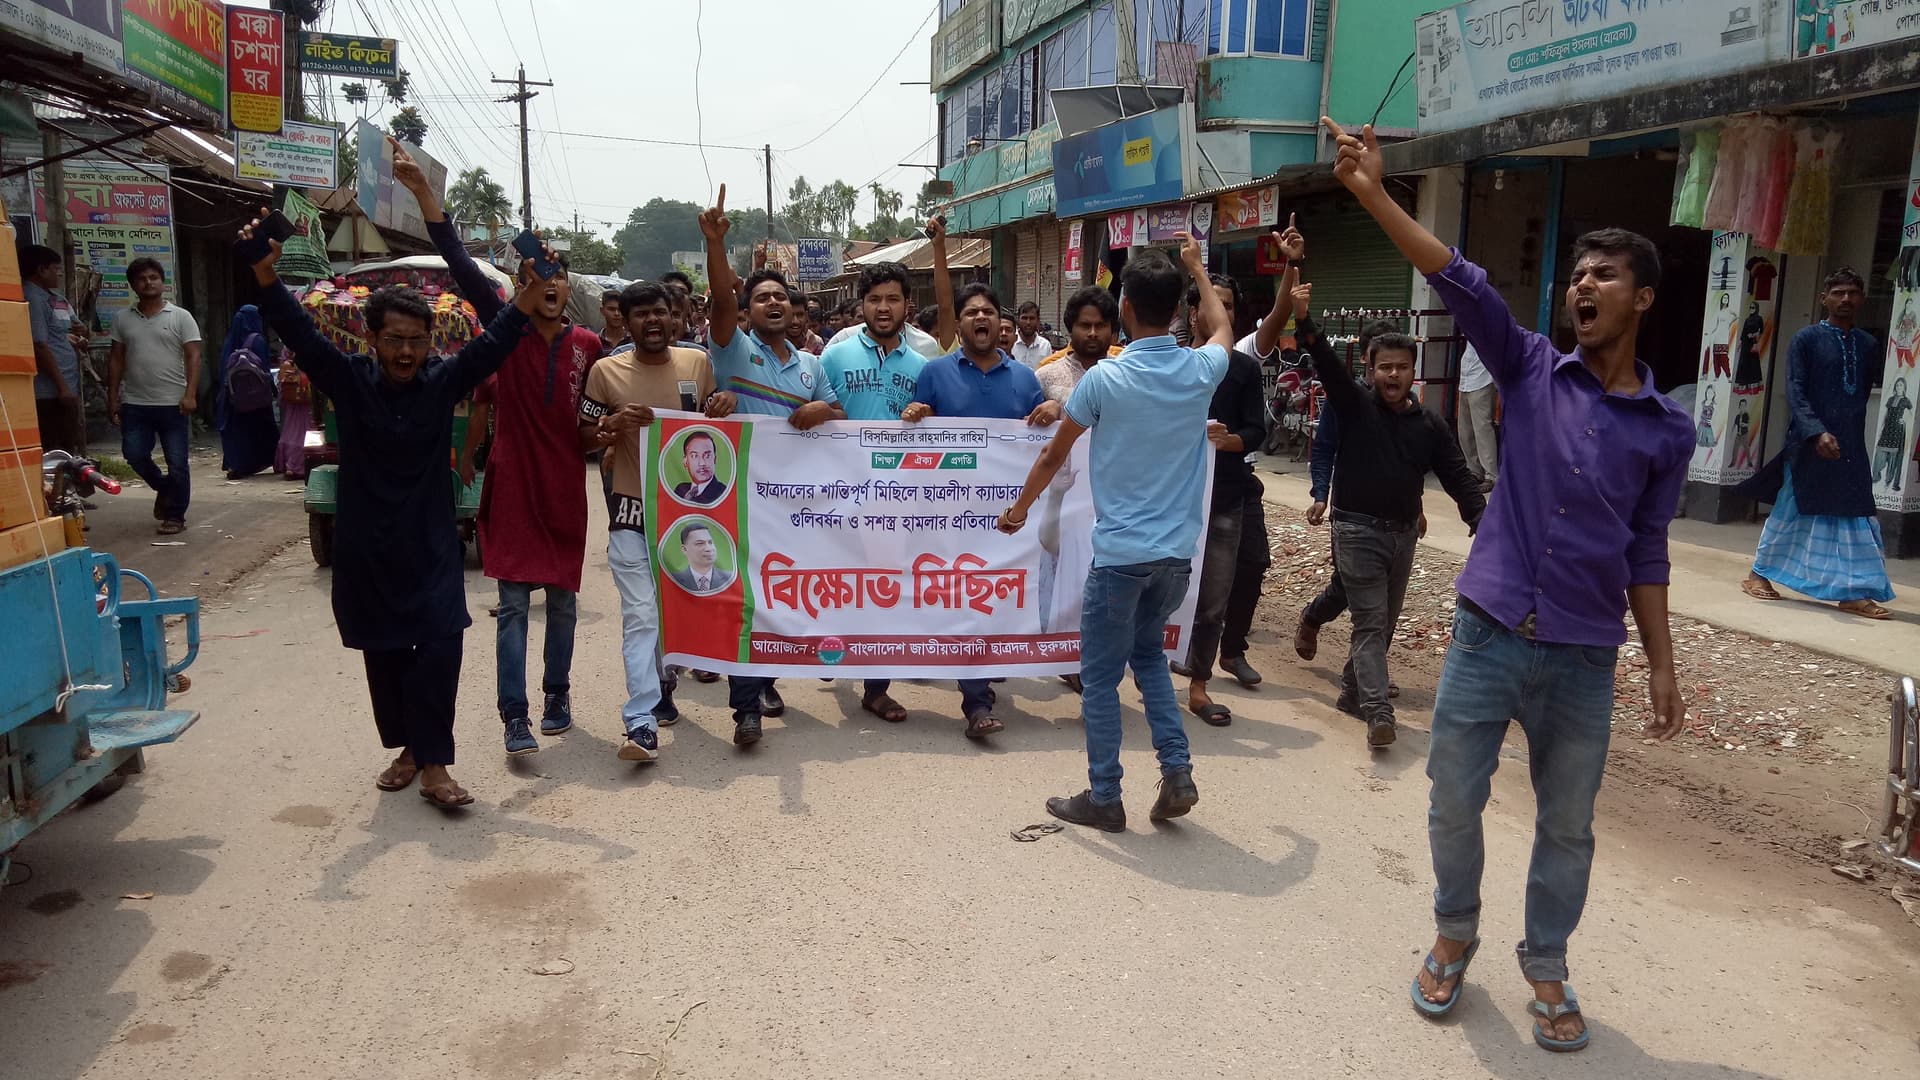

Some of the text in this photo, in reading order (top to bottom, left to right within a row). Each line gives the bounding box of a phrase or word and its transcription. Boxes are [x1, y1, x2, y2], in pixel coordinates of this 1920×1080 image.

[236, 12, 275, 39] মক্কা
[1896, 12, 1920, 30] পোশা
[231, 40, 281, 66] চশমা
[304, 39, 391, 64] লাইভ কিচেন
[241, 68, 270, 91] ঘর
[798, 238, 829, 255] সুন্দরবন
[960, 430, 984, 444] রাহিম
[875, 454, 895, 465] শিক্ষা
[951, 455, 973, 465] প্রগতি
[756, 481, 816, 500] ছাত্রদলের
[820, 479, 871, 506] শান্তিপূর্ণ
[874, 480, 918, 503] মিছিলে
[923, 480, 971, 502] ছাত্রলীগ
[790, 507, 843, 530] গুলিবর্ষন
[848, 516, 858, 529] ও
[863, 514, 897, 532] সশস্ত্র
[901, 514, 948, 534] হামলার
[759, 551, 1027, 620] বিক্ষোভ মিছিল
[752, 639, 808, 655] আয়োজনে
[848, 642, 905, 657] বাংলাদেশ
[910, 638, 987, 656] জাতীয়তাবাদী
[991, 640, 1034, 656] ছাত্রদল,
